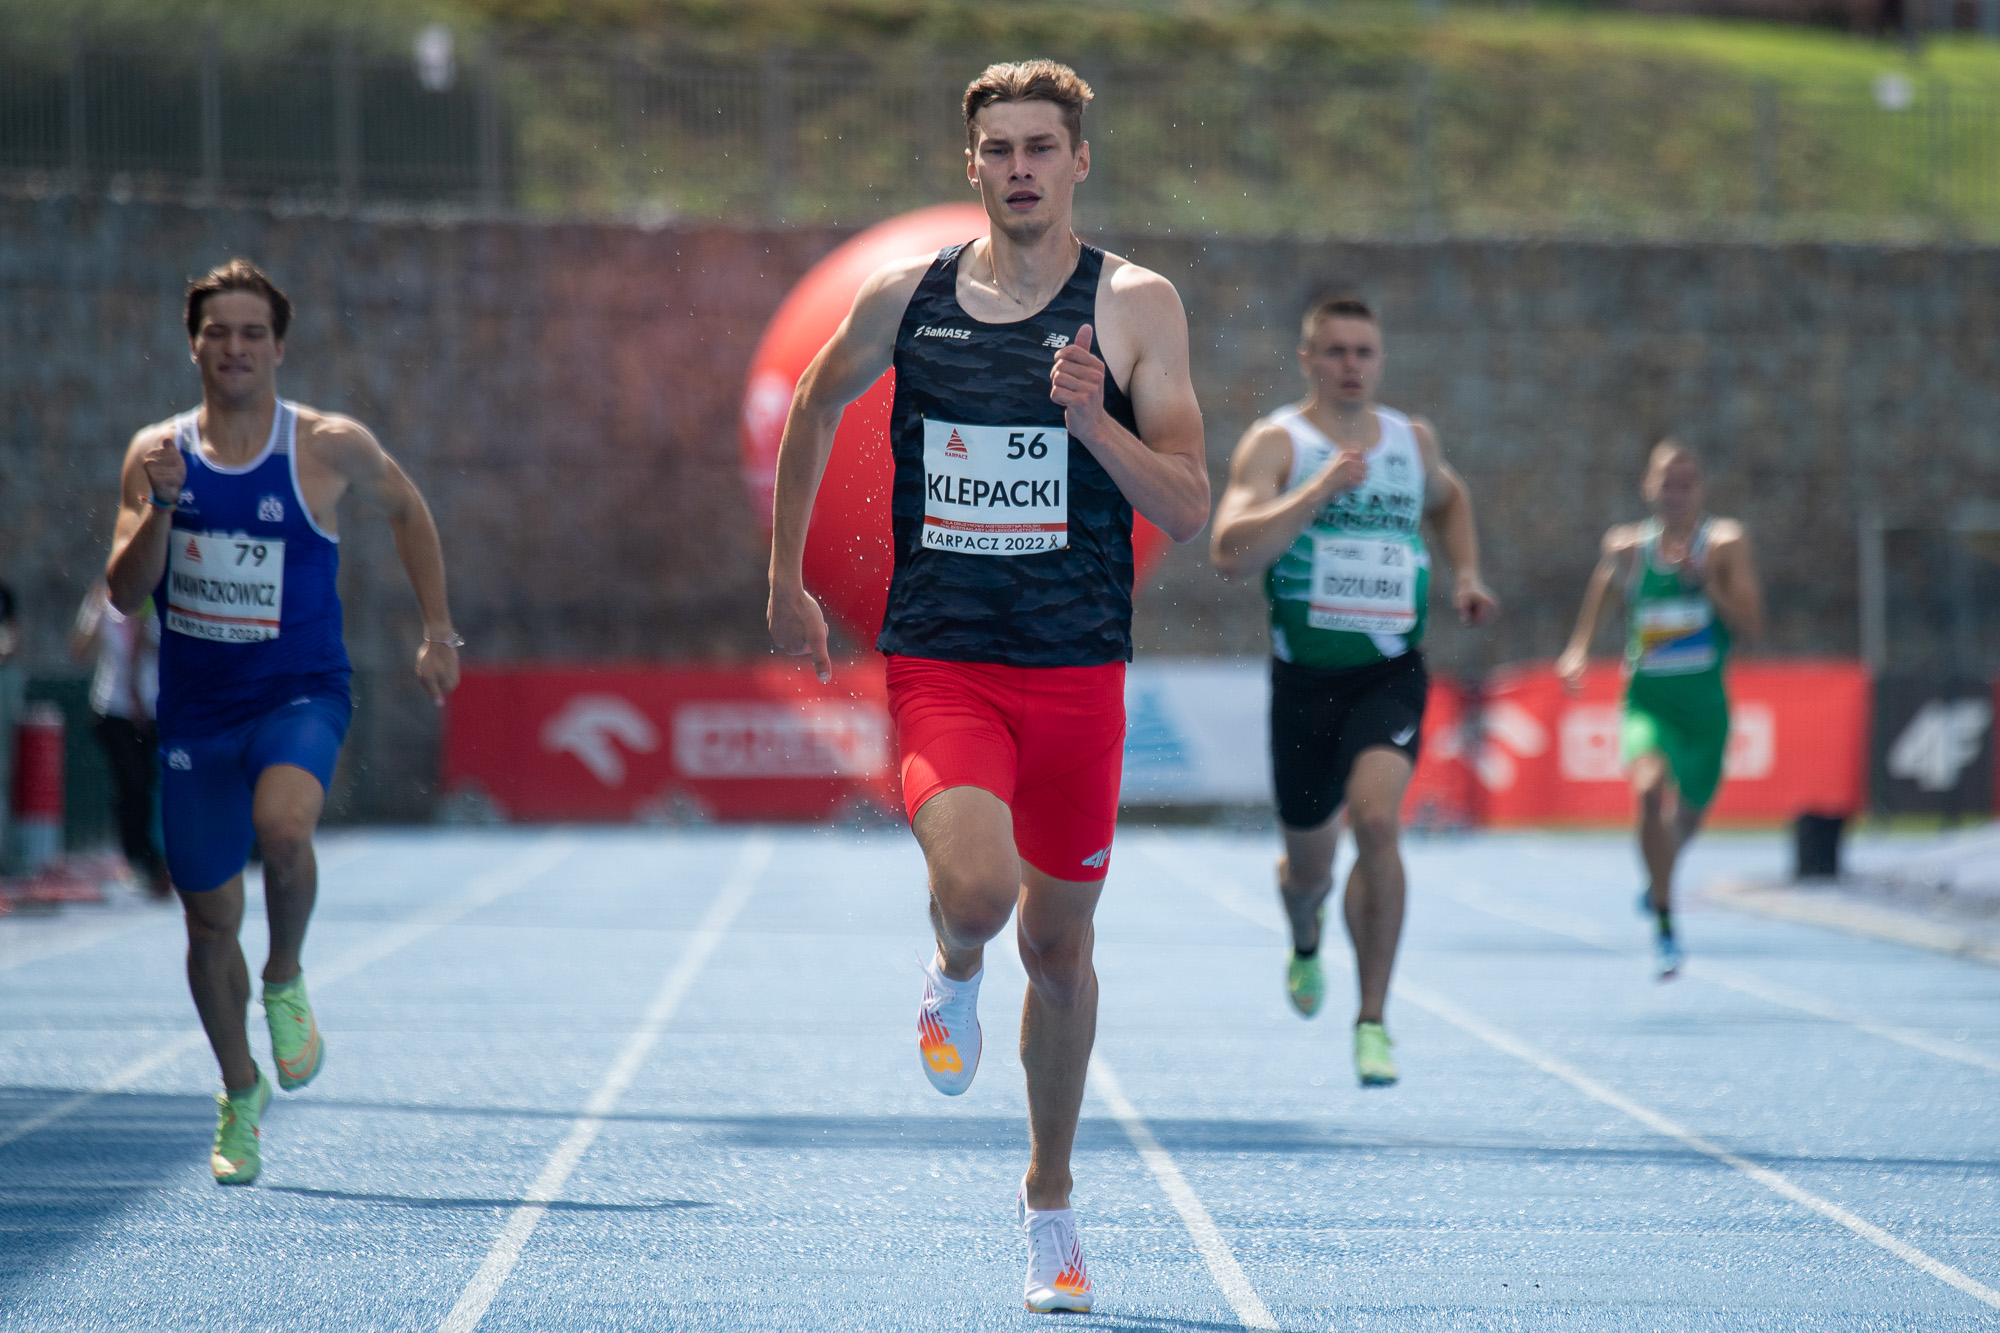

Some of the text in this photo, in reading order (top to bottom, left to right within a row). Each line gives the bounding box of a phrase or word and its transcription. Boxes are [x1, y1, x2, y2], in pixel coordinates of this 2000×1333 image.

[924, 327, 972, 340] SaMASZ
[944, 451, 968, 460] KARPACZ
[1006, 432, 1048, 460] 56
[927, 473, 1060, 507] KLEPACKI
[926, 530, 1045, 551] KARPACZ 2022
[235, 543, 268, 567] 79
